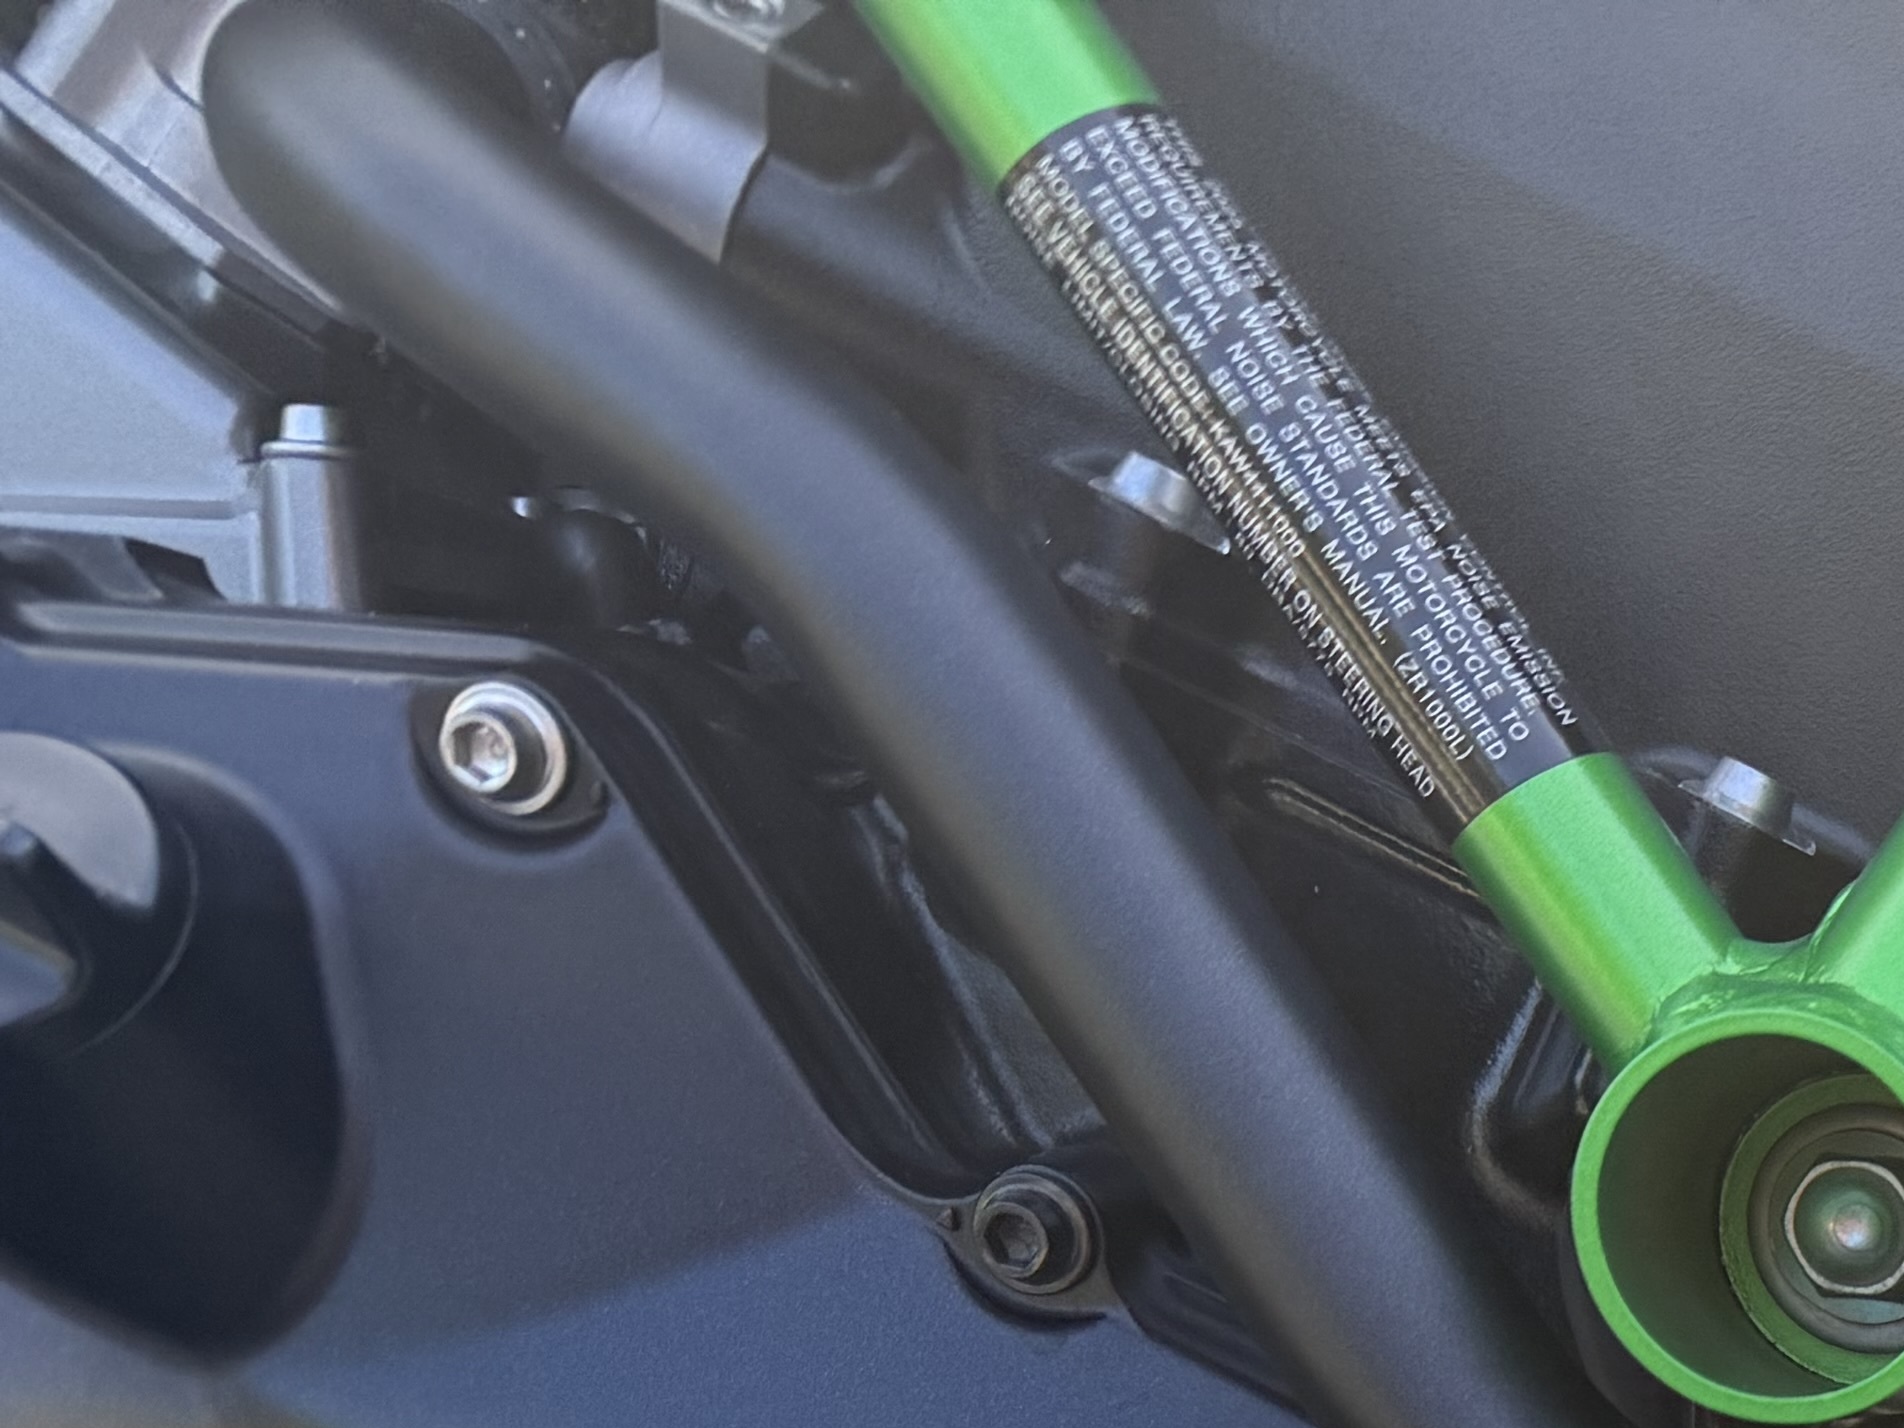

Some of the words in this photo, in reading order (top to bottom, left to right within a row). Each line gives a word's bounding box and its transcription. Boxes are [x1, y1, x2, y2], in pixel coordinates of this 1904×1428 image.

[1010, 171, 1056, 230] SEE
[1042, 219, 1119, 325] VEHICLE
[1107, 316, 1234, 497] IDENTIFICATION
[1225, 490, 1298, 593] NUMBER
[1290, 587, 1323, 630] ON
[1315, 624, 1395, 738] STEERING
[1388, 732, 1437, 800] HEAD
[1032, 152, 1100, 243] MODEL
[1087, 236, 1167, 347] SPECIFIC
[1056, 137, 1096, 180] BY
[1085, 181, 1170, 293] FEDERAL
[1159, 294, 1213, 359] LAW.
[1205, 364, 1251, 417] SEE
[1241, 420, 1327, 533] OWNER'S
[1391, 649, 1476, 761] (ZR1000L)
[1082, 126, 1158, 222] EXCEED
[1149, 228, 1231, 334] FEDERAL
[1223, 341, 1285, 416] NOISE
[1276, 422, 1379, 561] STANDARDS
[1371, 567, 1416, 618] ARE
[1408, 625, 1510, 761] PROHIBITED
[1110, 116, 1243, 297] MODIFICATIONS
[1234, 307, 1300, 385] WHICH
[1291, 394, 1357, 472] CAUSE
[1349, 483, 1397, 534] THIS
[1389, 545, 1505, 699] MOTORCYCLE
[1497, 710, 1532, 741] TO
[1136, 116, 1264, 288] REQUIREMENTS
[1259, 302, 1293, 332] BY
[1289, 349, 1329, 386] THE
[1323, 400, 1400, 493] FEDERAL
[1397, 512, 1446, 563] TEST
[1445, 545, 1502, 609] NOISE
[1496, 622, 1578, 723] EMISSION
